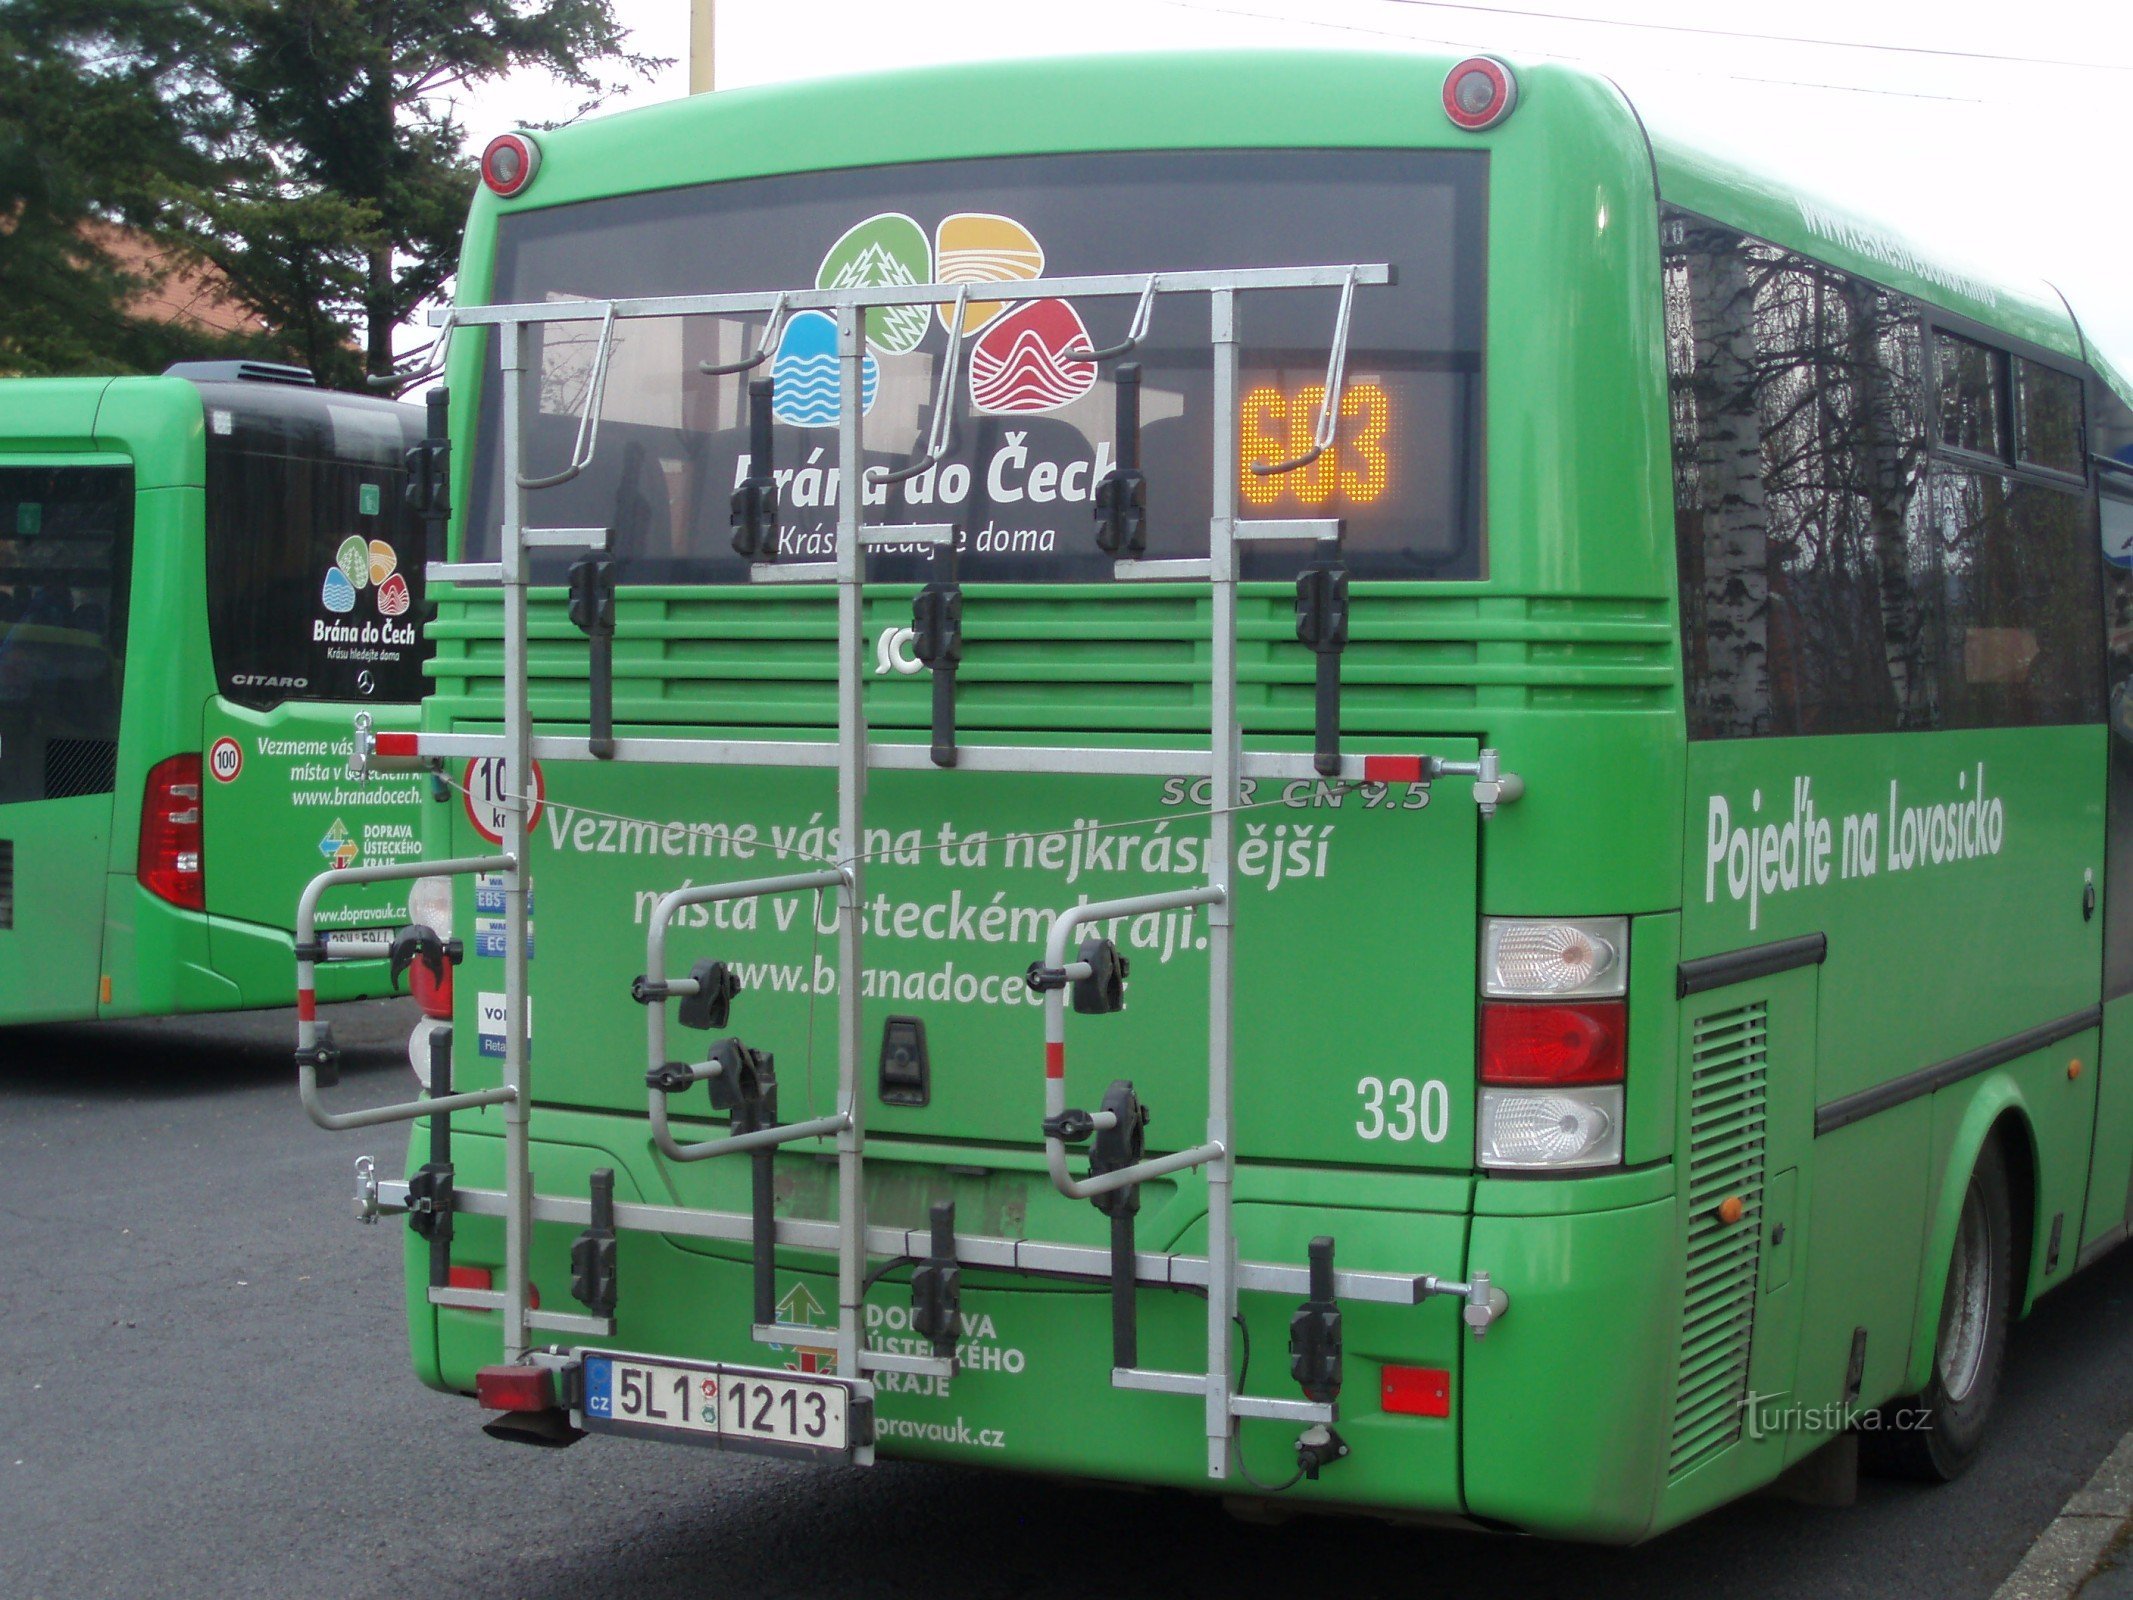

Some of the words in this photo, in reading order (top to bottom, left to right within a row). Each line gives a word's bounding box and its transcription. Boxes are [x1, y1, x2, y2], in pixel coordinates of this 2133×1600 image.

[1241, 385, 1388, 503] 663
[904, 446, 971, 503] do
[976, 521, 1055, 552] doma
[313, 619, 359, 642] Brána
[361, 621, 379, 643] do
[382, 618, 415, 645] Čech
[327, 647, 348, 660] Krásu
[350, 648, 379, 662] hledejte
[380, 649, 400, 661] doma
[231, 674, 309, 689] CITARO
[217, 751, 236, 769] 100
[258, 738, 328, 756] Vezmeme
[331, 737, 353, 756] vás
[291, 763, 330, 781] místa
[333, 767, 341, 781] v
[481, 757, 506, 802] 10
[293, 787, 422, 806] www.branadocech.
[1282, 779, 1346, 808] CN
[1360, 781, 1432, 810] 9.5
[364, 825, 412, 837] DOPRAVA
[547, 807, 757, 859] Vezmeme
[772, 813, 840, 862] vás
[864, 827, 921, 866] na
[938, 822, 987, 867] ta
[364, 839, 422, 855] ÚSTECKÉHO
[1706, 776, 1831, 931] Pojeďte
[1841, 811, 1877, 879] na
[1888, 761, 2003, 871] Lovosicko
[479, 893, 500, 907] EBS
[773, 898, 799, 931] v
[485, 1040, 506, 1052] Reta
[1356, 1076, 1449, 1143] 330
[591, 1397, 609, 1411] CZ
[621, 1368, 689, 1421] 5L1
[729, 1382, 826, 1438] 1213
[875, 1416, 1006, 1448] pravauk.cz
